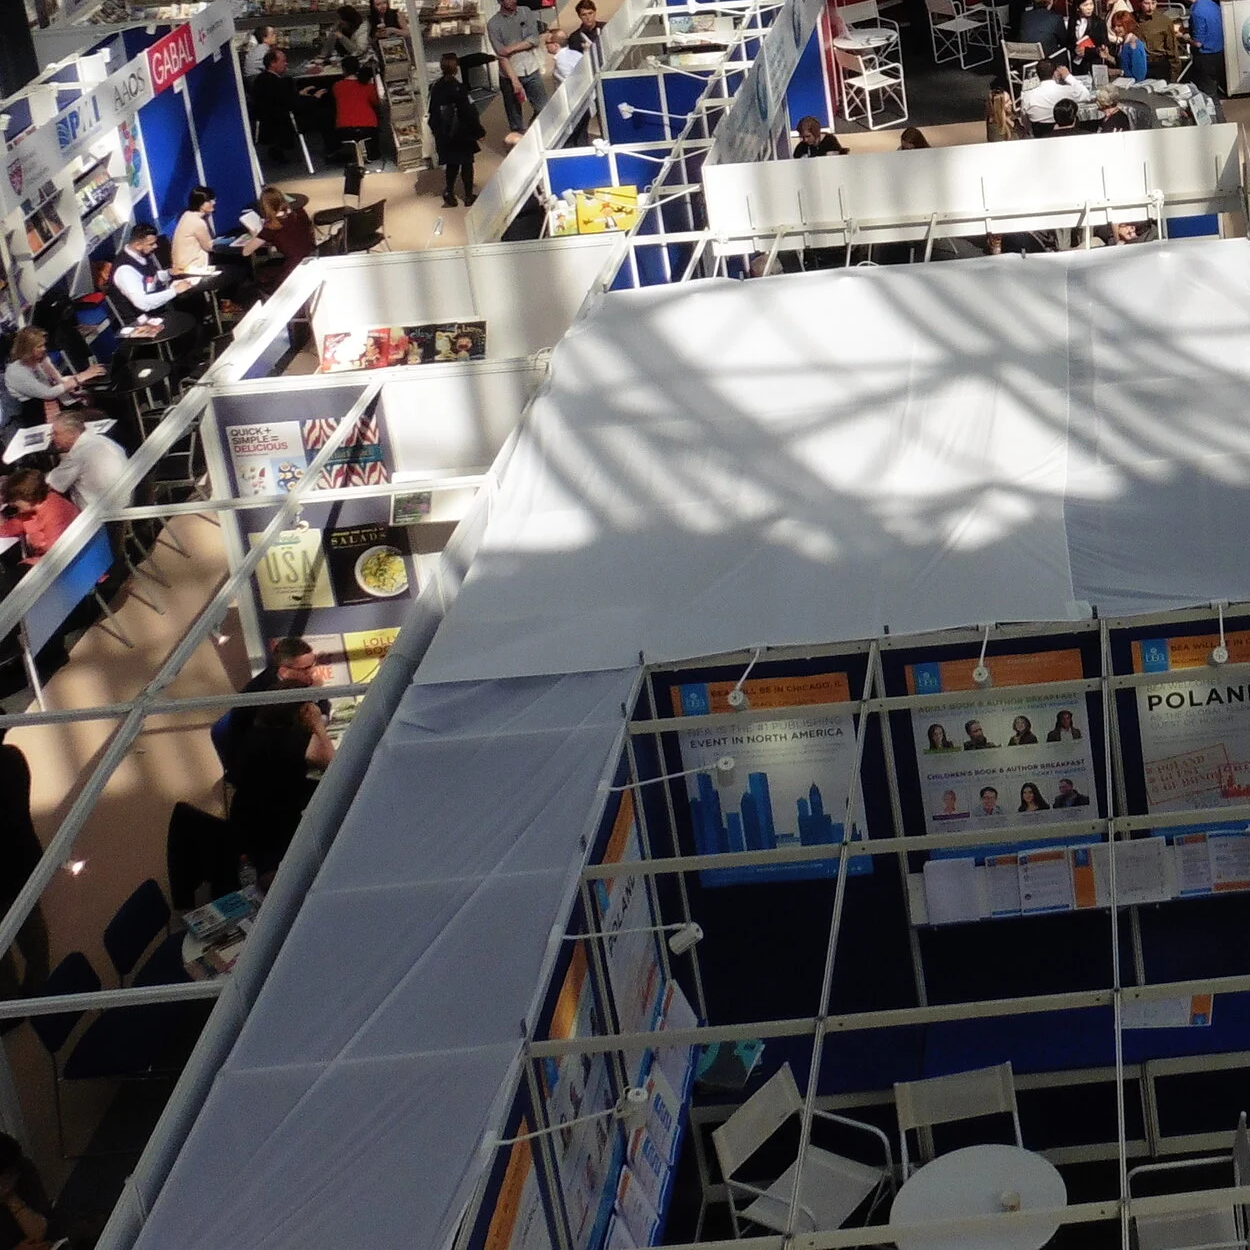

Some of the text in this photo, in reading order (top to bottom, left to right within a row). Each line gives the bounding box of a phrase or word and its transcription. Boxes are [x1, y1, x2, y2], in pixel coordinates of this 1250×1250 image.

[152, 34, 194, 85] GABAL
[113, 67, 146, 112] AAOS
[234, 441, 288, 453] DELICIOUS
[331, 532, 386, 546] SALADS
[265, 550, 316, 584] USA
[1193, 641, 1216, 650] WILL
[759, 686, 770, 695] BE
[774, 685, 784, 693] IN
[918, 704, 947, 713] ADULT
[948, 701, 975, 710] BOOK
[986, 697, 1024, 706] AUTHOR
[1025, 692, 1078, 702] BREAKFAST
[1165, 711, 1182, 720] THE
[1185, 707, 1224, 718] GLOBAL
[729, 724, 753, 734] THE
[757, 723, 769, 732] #1
[771, 716, 843, 731] PUBLISHING
[1151, 716, 1233, 730] GUEST OF HONOR
[690, 727, 844, 749] EVENT IN NORTH AMERICA
[926, 769, 974, 780] CHILDREN'S
[974, 768, 997, 776] BOOK
[1006, 764, 1038, 773] AUTHOR
[1040, 758, 1085, 769] BREAKFAST
[1157, 755, 1205, 774] POLAND
[1161, 768, 1199, 783] GUEST
